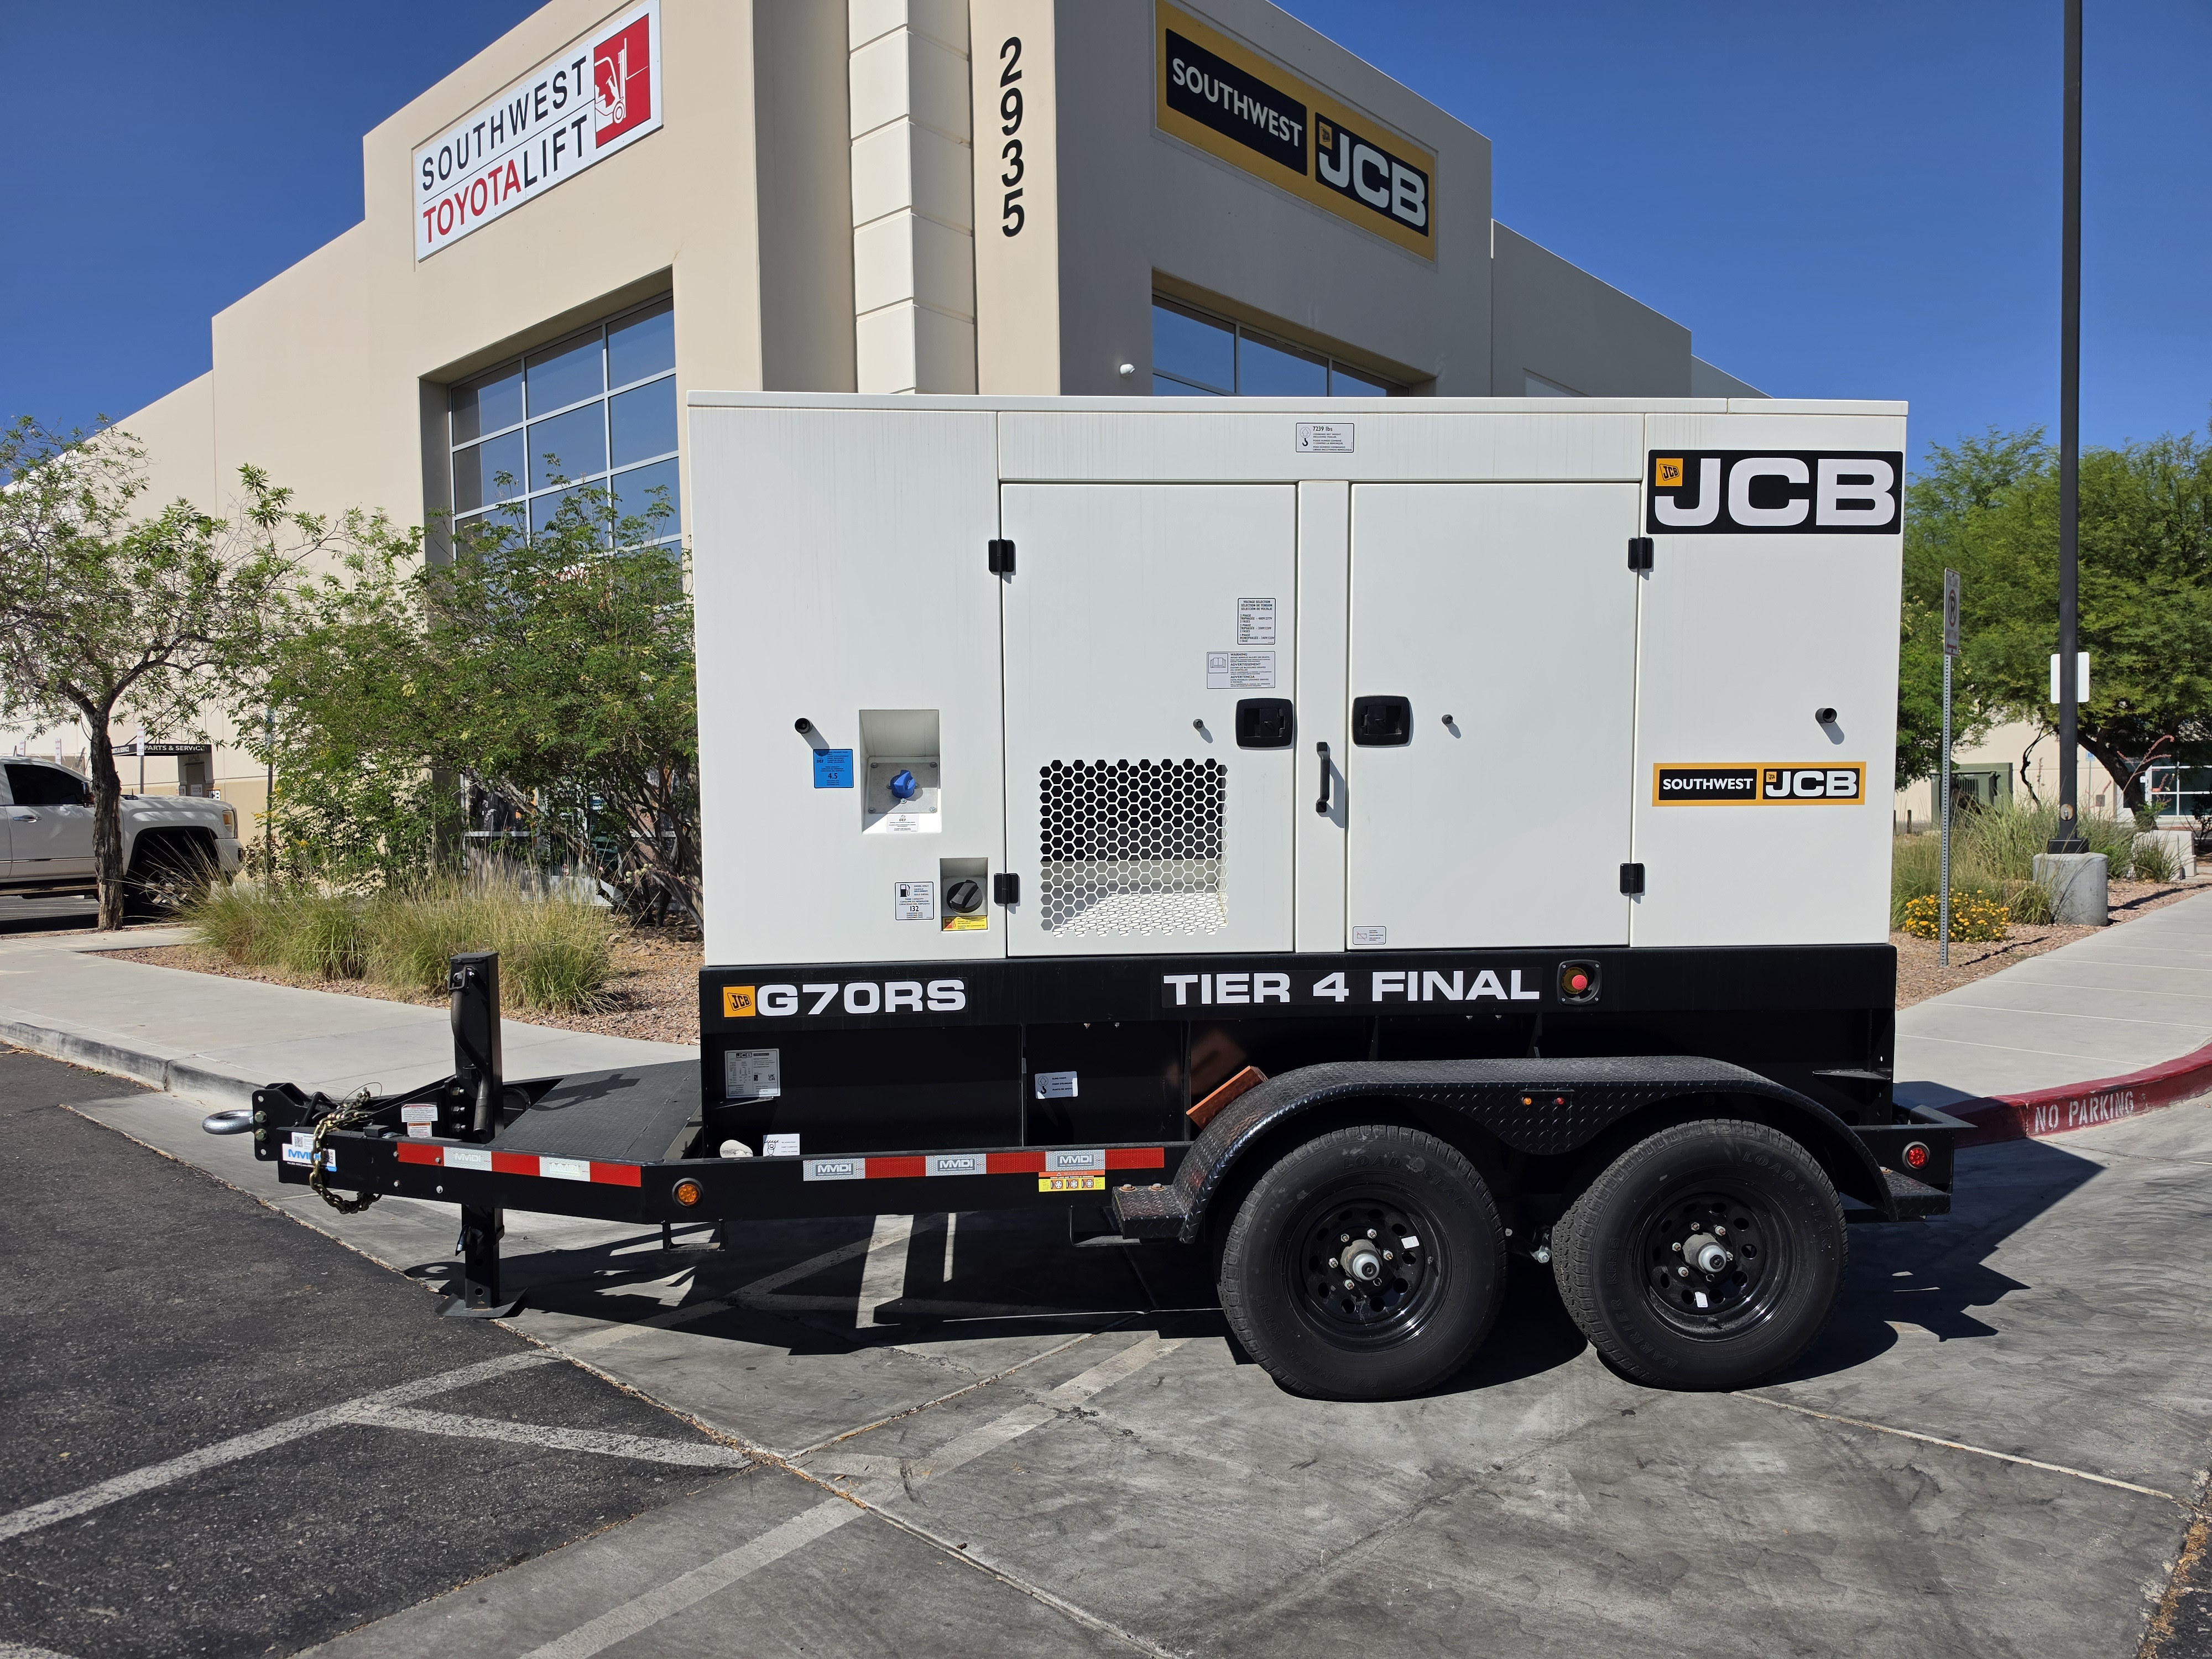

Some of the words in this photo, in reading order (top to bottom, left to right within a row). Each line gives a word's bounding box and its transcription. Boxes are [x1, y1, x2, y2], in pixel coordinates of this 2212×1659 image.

[422, 55, 586, 191] SOUTHWEST
[1000, 36, 1024, 237] 2935
[1172, 58, 1302, 147] SOUTHWEST
[1319, 133, 1426, 227] JCB
[423, 114, 587, 244] TOYOTALIFT
[1655, 458, 1895, 526] JCB
[1663, 466, 1679, 479] JCB
[1663, 778, 1753, 790] SOUTHWEST
[1765, 770, 1857, 797] JCB
[732, 995, 750, 1009] JCB
[757, 979, 966, 1016] G70RS
[1164, 972, 1290, 1005] TIER
[1313, 972, 1349, 1002] 4
[1372, 969, 1540, 1001] FINAL
[2034, 1104, 2059, 1133] NO
[2069, 1091, 2134, 1126] PARKING
[455, 1153, 481, 1162] MMDI
[818, 1164, 852, 1173] MMDI
[940, 1159, 973, 1168] MMDI
[1060, 1155, 1092, 1164] MMDI
[1342, 1155, 1402, 1170] LOAD
[1420, 1168, 1472, 1213] STAR
[1742, 1151, 1797, 1183] LOAD
[1804, 1194, 1833, 1249] STAR
[1610, 1298, 1679, 1370] KARRIER
[1285, 1347, 1380, 1389] KARRIER
